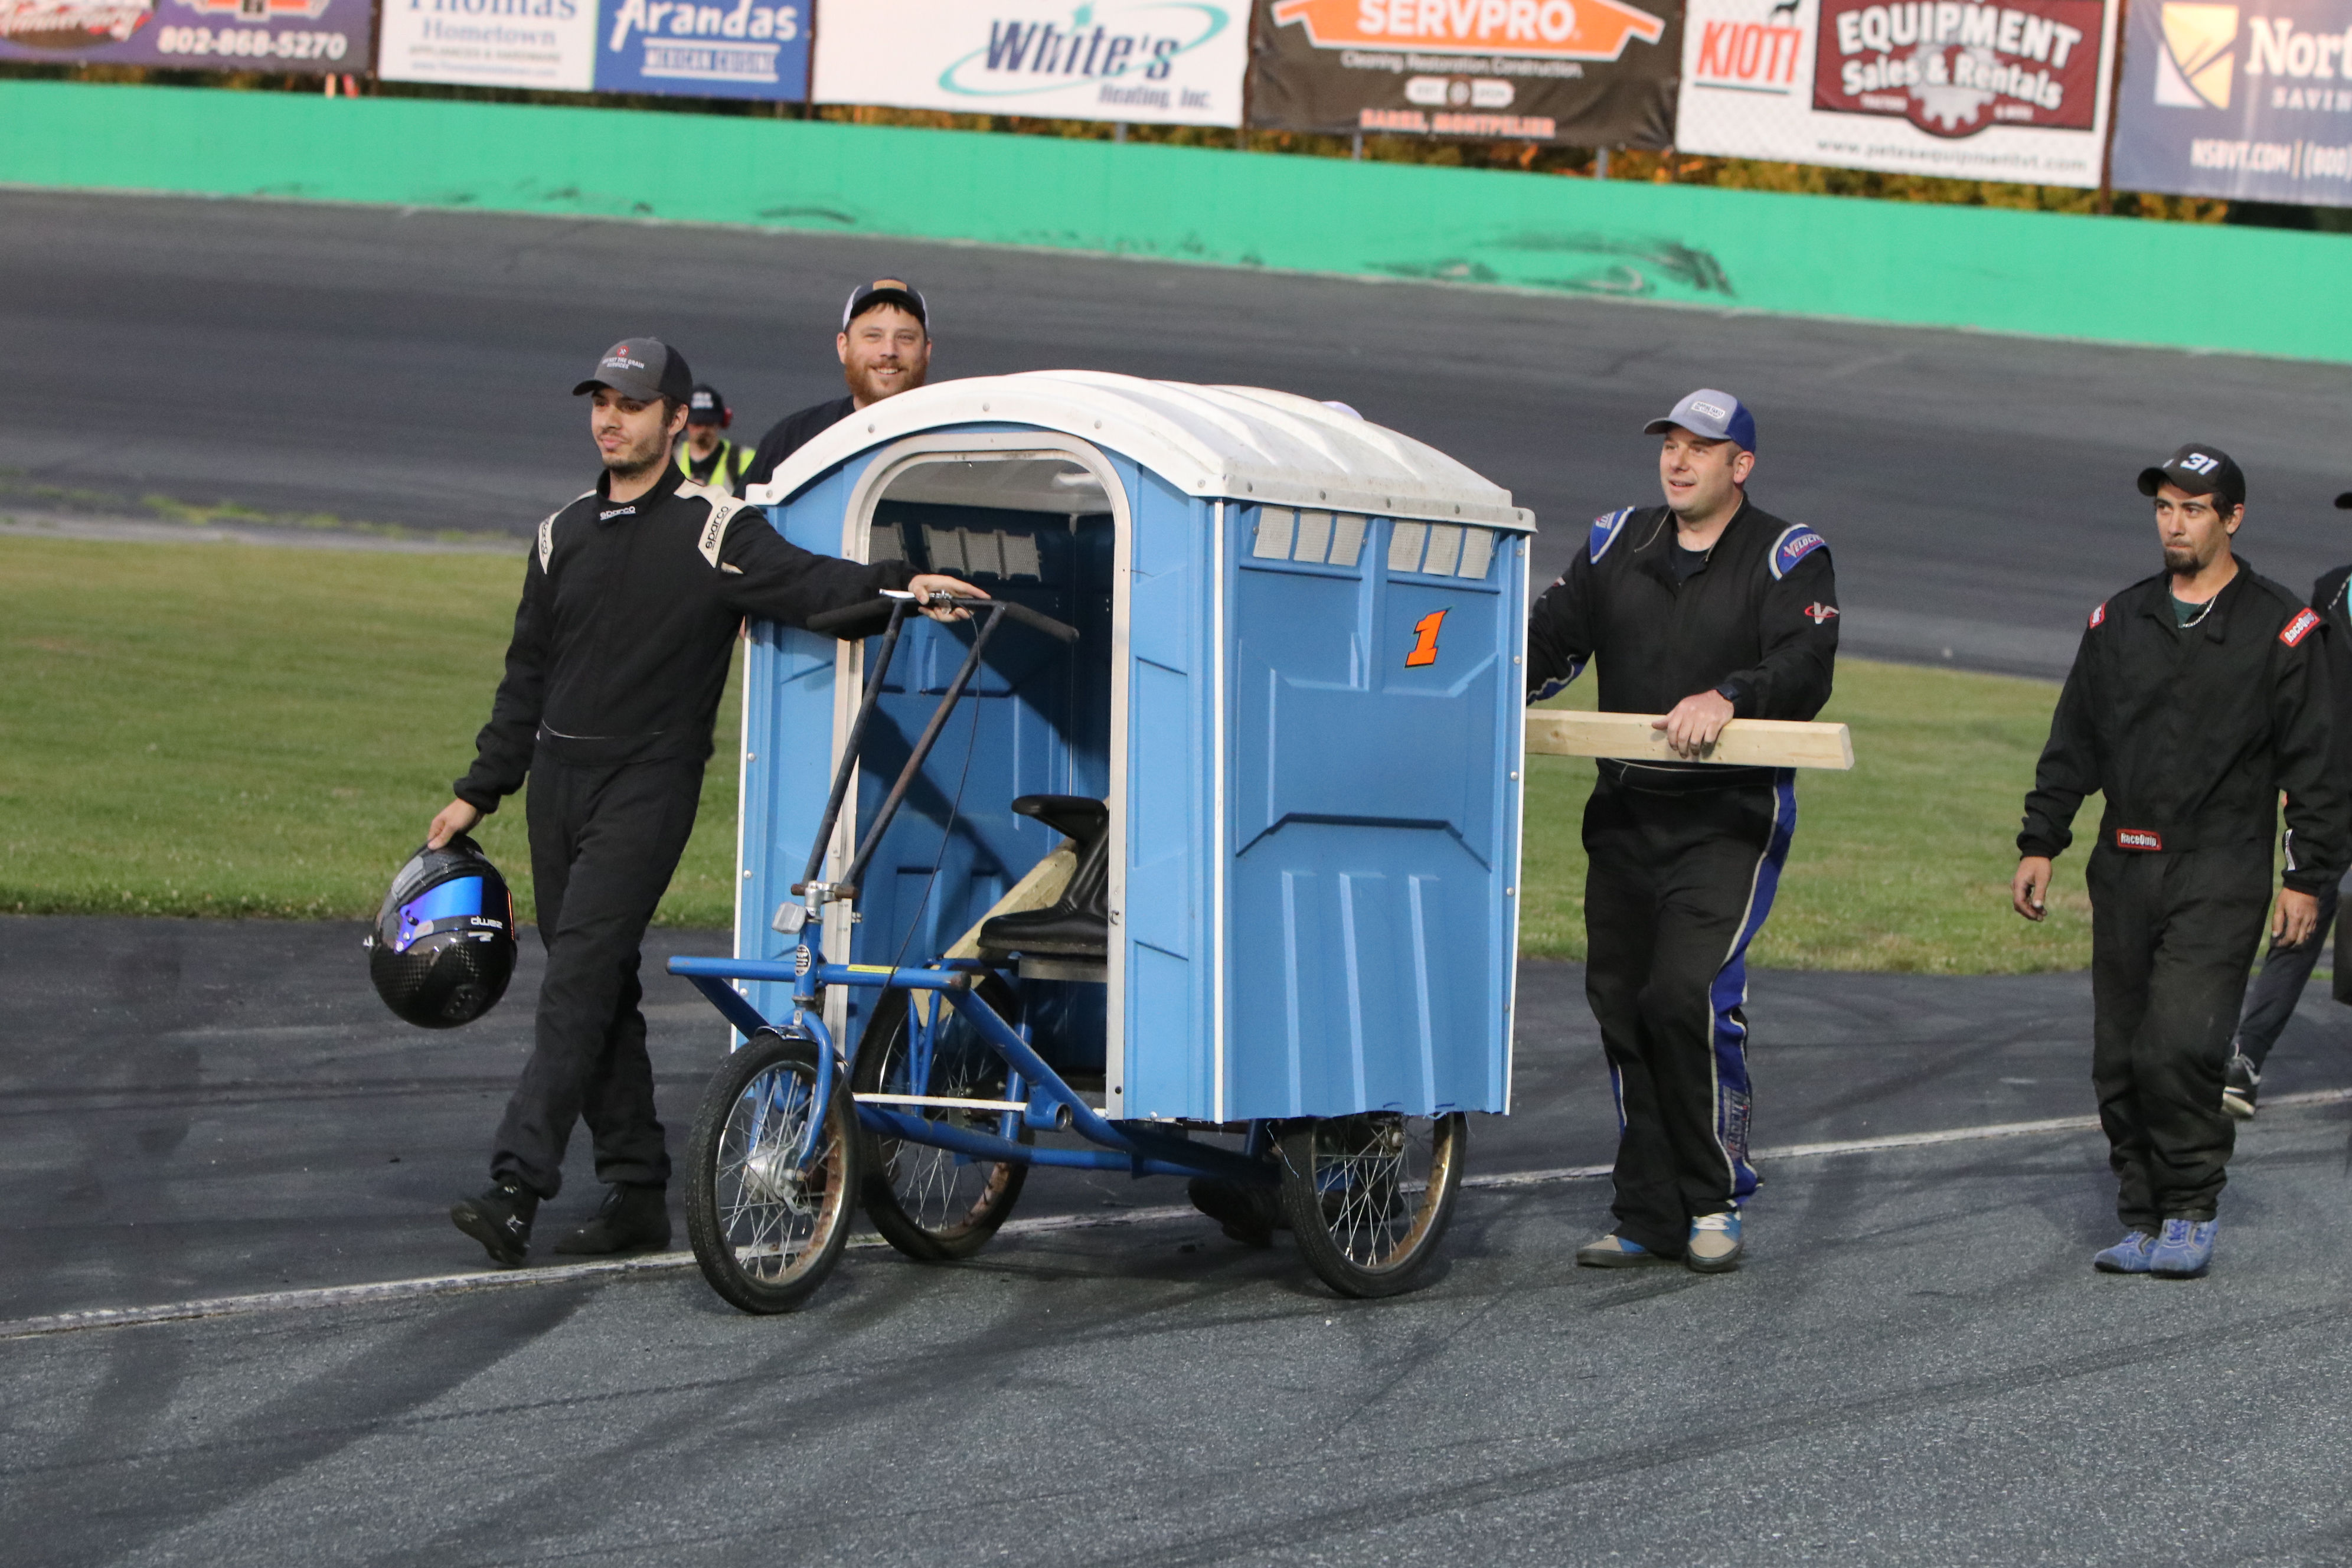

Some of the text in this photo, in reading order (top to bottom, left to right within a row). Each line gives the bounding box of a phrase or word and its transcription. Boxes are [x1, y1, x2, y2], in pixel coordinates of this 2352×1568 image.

[423, 17, 557, 45] Hometown
[609, 0, 797, 51] Arandas
[1358, 0, 1576, 42] SERVPRO
[1837, 2, 2082, 70] EQUIPMENT
[158, 27, 348, 59] 802-868-5270
[986, 19, 1180, 80] White's
[1842, 55, 1919, 97] Sales
[1927, 53, 1949, 87] &
[1953, 53, 2063, 110] Rentals
[1433, 112, 1556, 138] MONTPELIER
[628, 359, 645, 369] GRAIN
[2180, 452, 2219, 475] 31
[1404, 605, 1453, 669] 1
[2284, 612, 2316, 642] RaceQuip
[2121, 832, 2157, 847] RaceQuip
[470, 915, 503, 929] zamp
